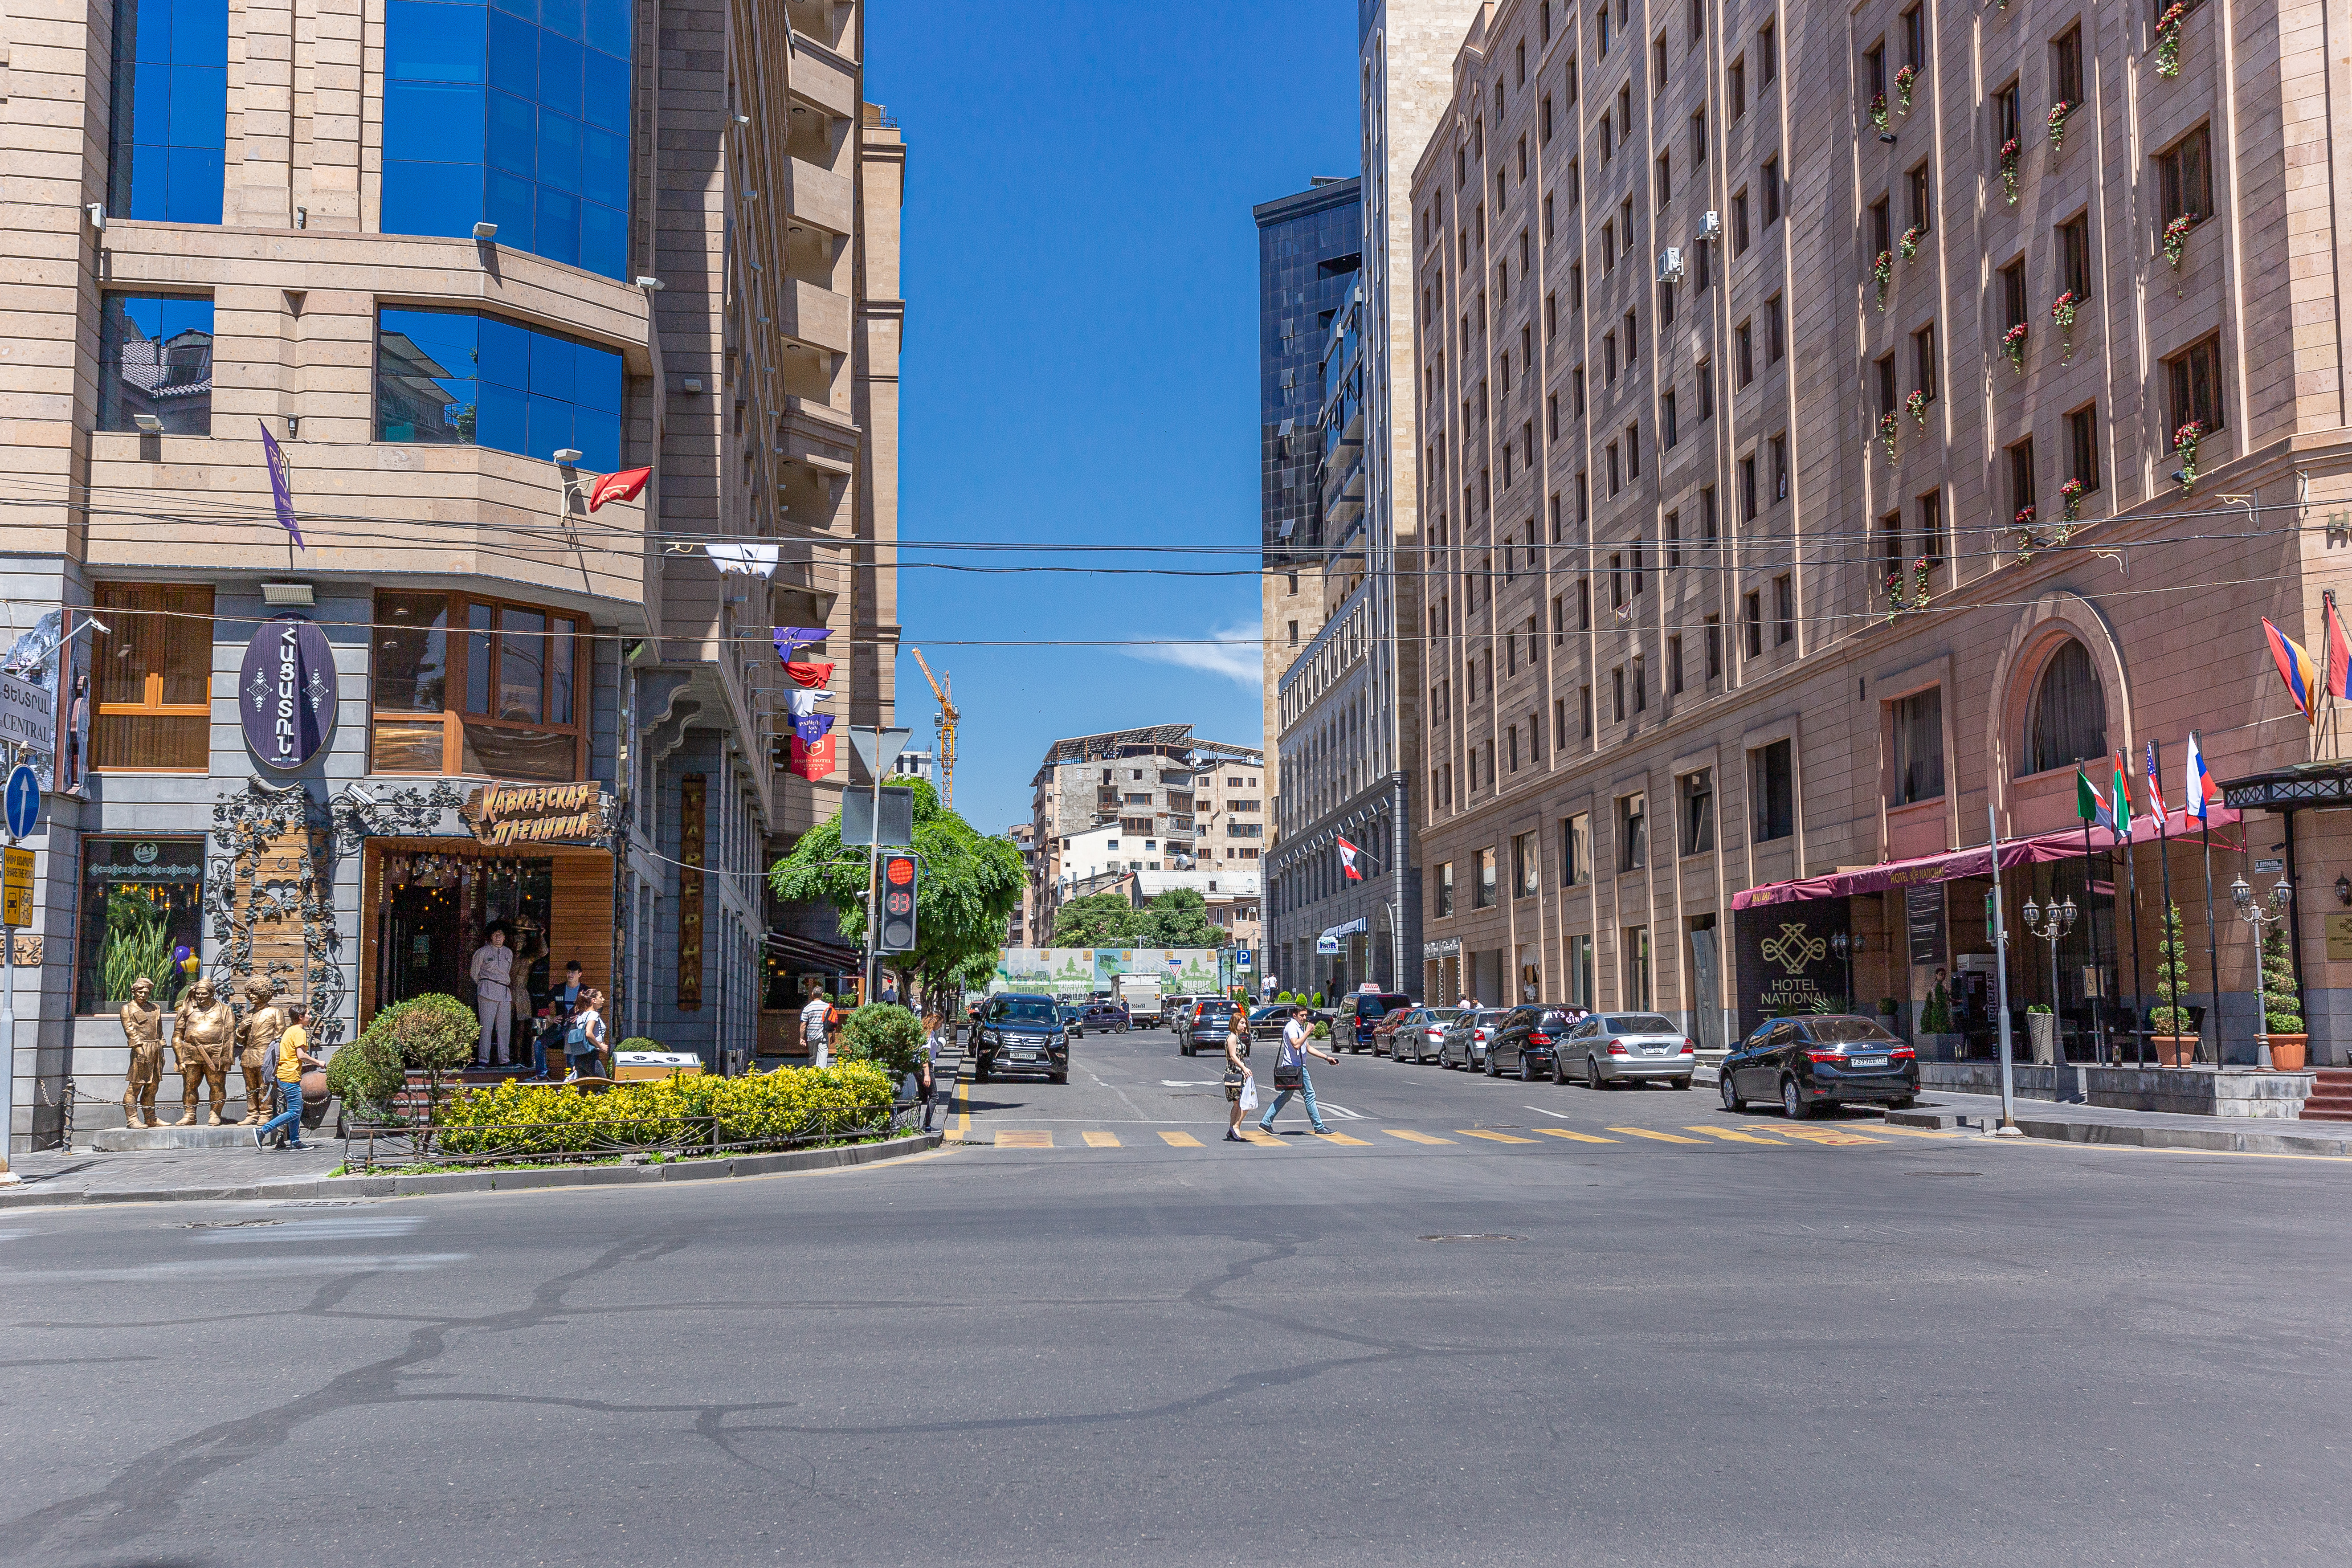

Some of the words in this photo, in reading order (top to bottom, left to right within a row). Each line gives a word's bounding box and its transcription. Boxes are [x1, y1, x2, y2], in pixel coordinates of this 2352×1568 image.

[4, 683, 49, 715] ՑԵՆՏՐԱԼ
[4, 713, 49, 743] CENTRAL
[479, 779, 589, 824] КАВКАЗСКАЯ
[6, 866, 17, 877] SHARE
[1890, 872, 1909, 884] HOTEL
[1919, 866, 1945, 879] NATIONAL
[890, 893, 910, 911] 33
[1240, 952, 1248, 964] P
[1772, 979, 1819, 991] HOTEL
[1549, 1010, 1565, 1018] IT'S
